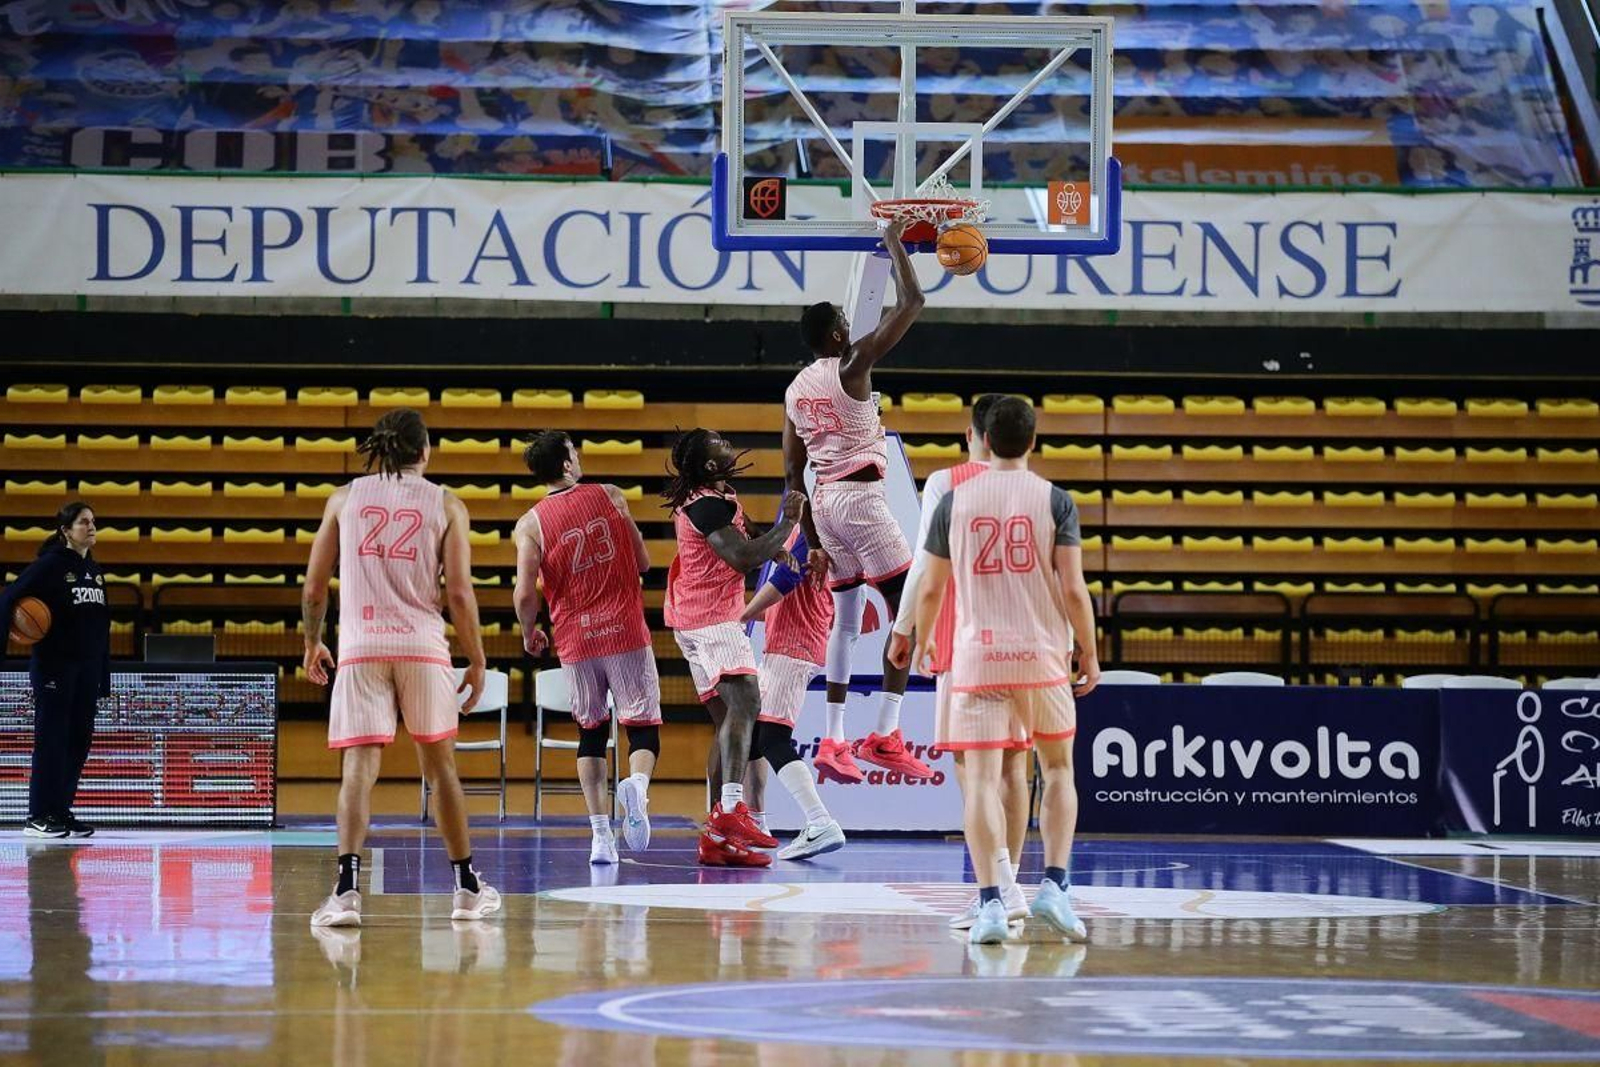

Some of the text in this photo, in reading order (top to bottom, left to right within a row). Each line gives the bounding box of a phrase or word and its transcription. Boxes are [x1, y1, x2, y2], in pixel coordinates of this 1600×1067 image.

[1122, 161, 1382, 187] telemiño
[86, 189, 806, 294] DEPUTACIÓN
[796, 397, 843, 435] 35
[358, 505, 424, 562] 22
[560, 516, 616, 574] 23
[970, 515, 1036, 576] 28
[983, 651, 1038, 662] ABANCA
[1092, 724, 1420, 780] Arkivolta
[1095, 787, 1418, 806] construcción y mantenimientos
